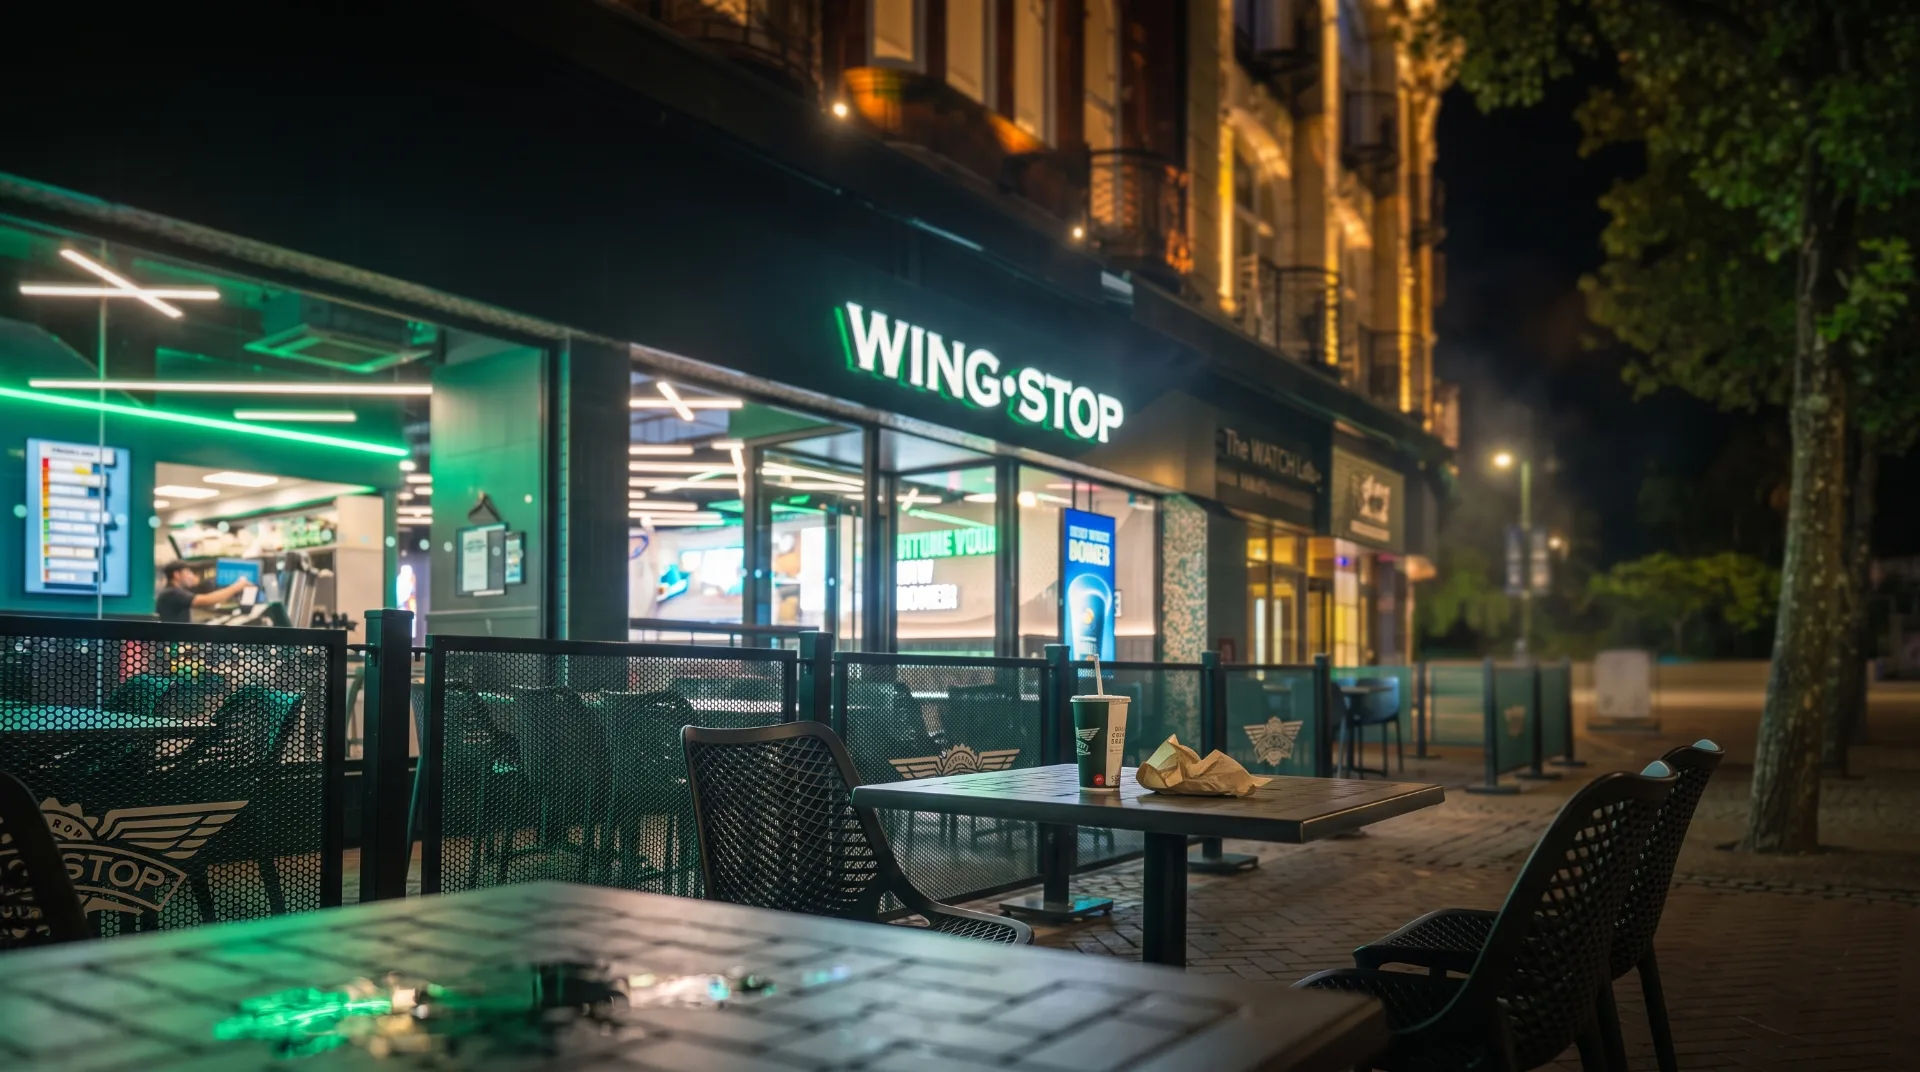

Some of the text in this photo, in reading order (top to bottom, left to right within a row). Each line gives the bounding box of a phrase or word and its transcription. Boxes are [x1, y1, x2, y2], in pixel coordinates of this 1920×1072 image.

[1224, 428, 1249, 460] The
[1250, 438, 1296, 477] WATCH
[62, 853, 166, 891] STOP
